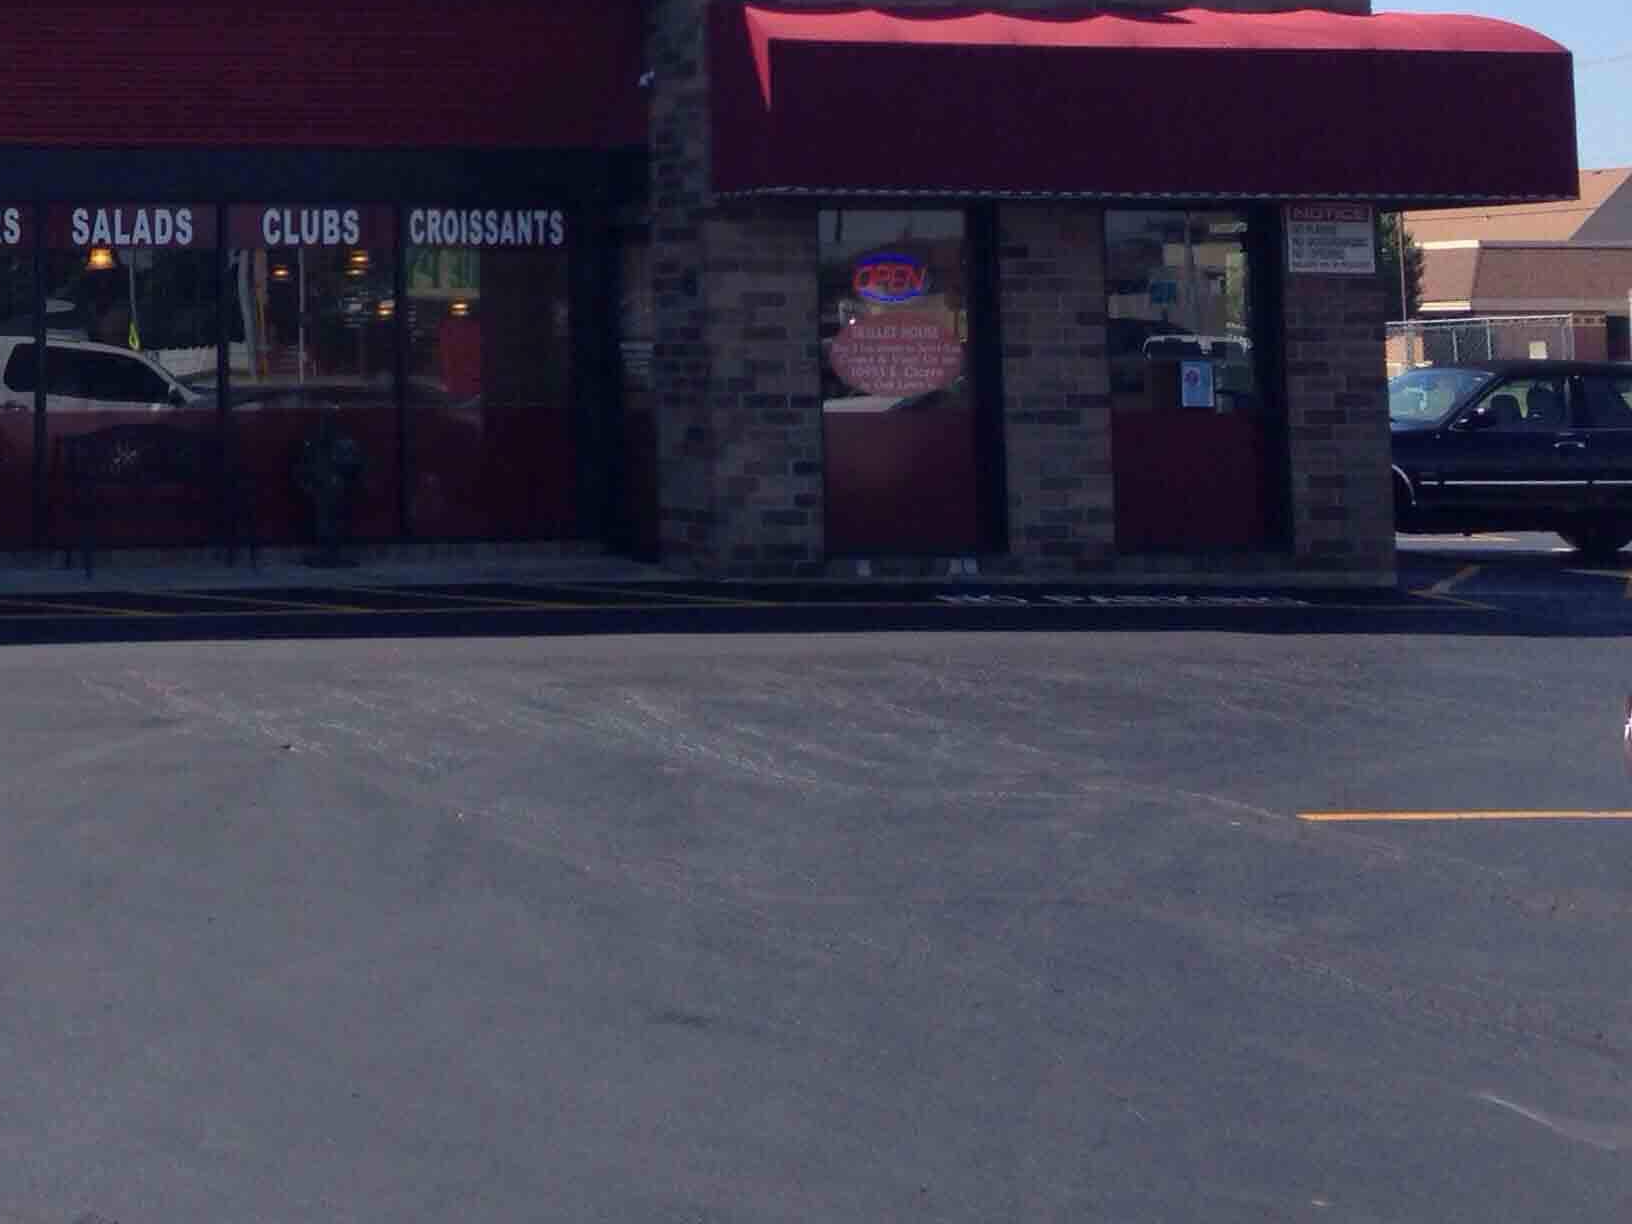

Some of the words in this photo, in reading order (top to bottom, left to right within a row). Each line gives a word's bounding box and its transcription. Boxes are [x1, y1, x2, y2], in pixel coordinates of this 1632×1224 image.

[71, 208, 194, 247] SALADS
[262, 208, 361, 246] CLUBS
[409, 209, 565, 246] CROISSANTS
